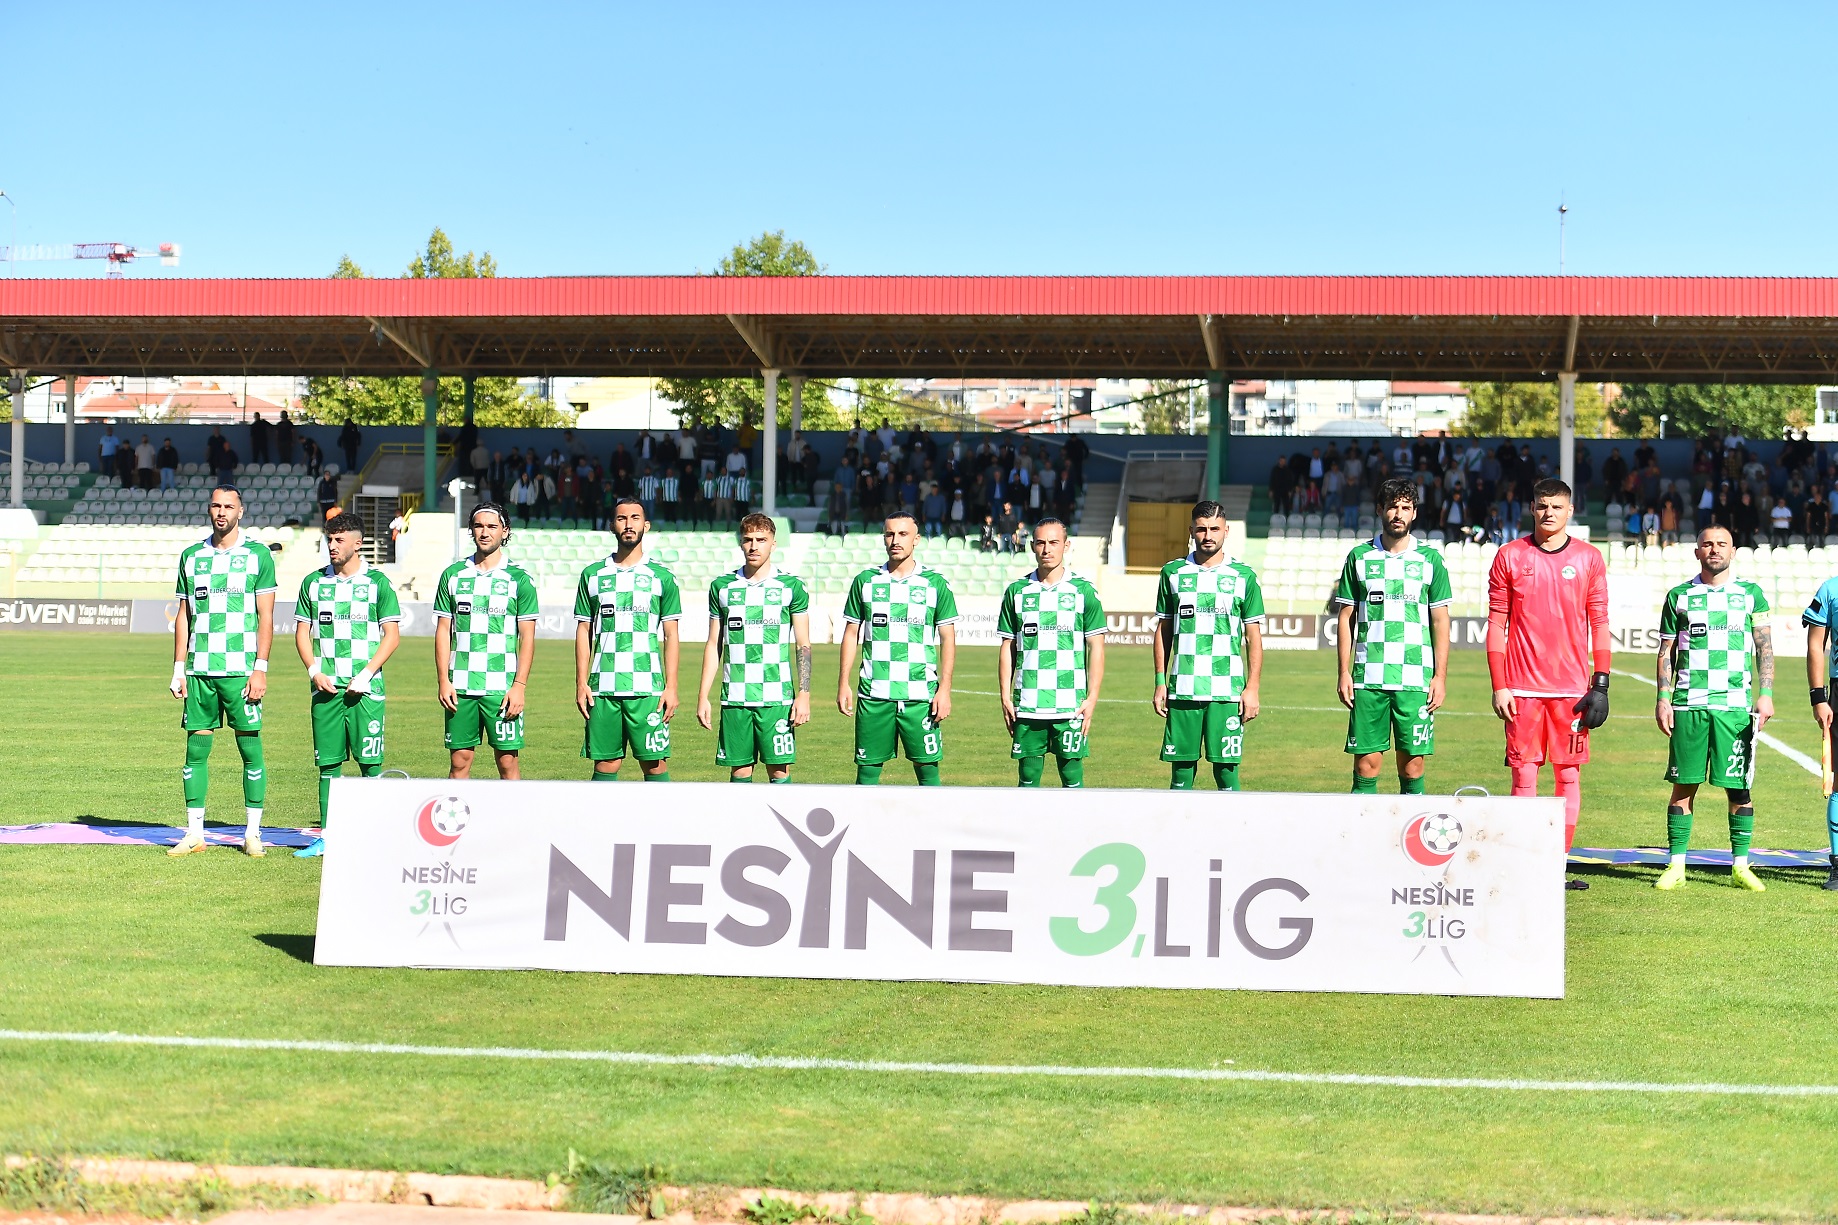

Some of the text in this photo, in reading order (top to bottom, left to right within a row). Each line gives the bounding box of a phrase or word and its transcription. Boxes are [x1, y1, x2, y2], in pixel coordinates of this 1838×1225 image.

[0, 600, 75, 624] GÜVEN
[98, 603, 128, 617] Market
[645, 730, 665, 753] 45
[772, 733, 794, 756] 88
[1062, 730, 1081, 753] 93
[1221, 735, 1242, 758] 28
[1412, 724, 1430, 746] 54
[1567, 734, 1584, 755] 16
[361, 736, 381, 758] 20
[1725, 754, 1745, 777] 23
